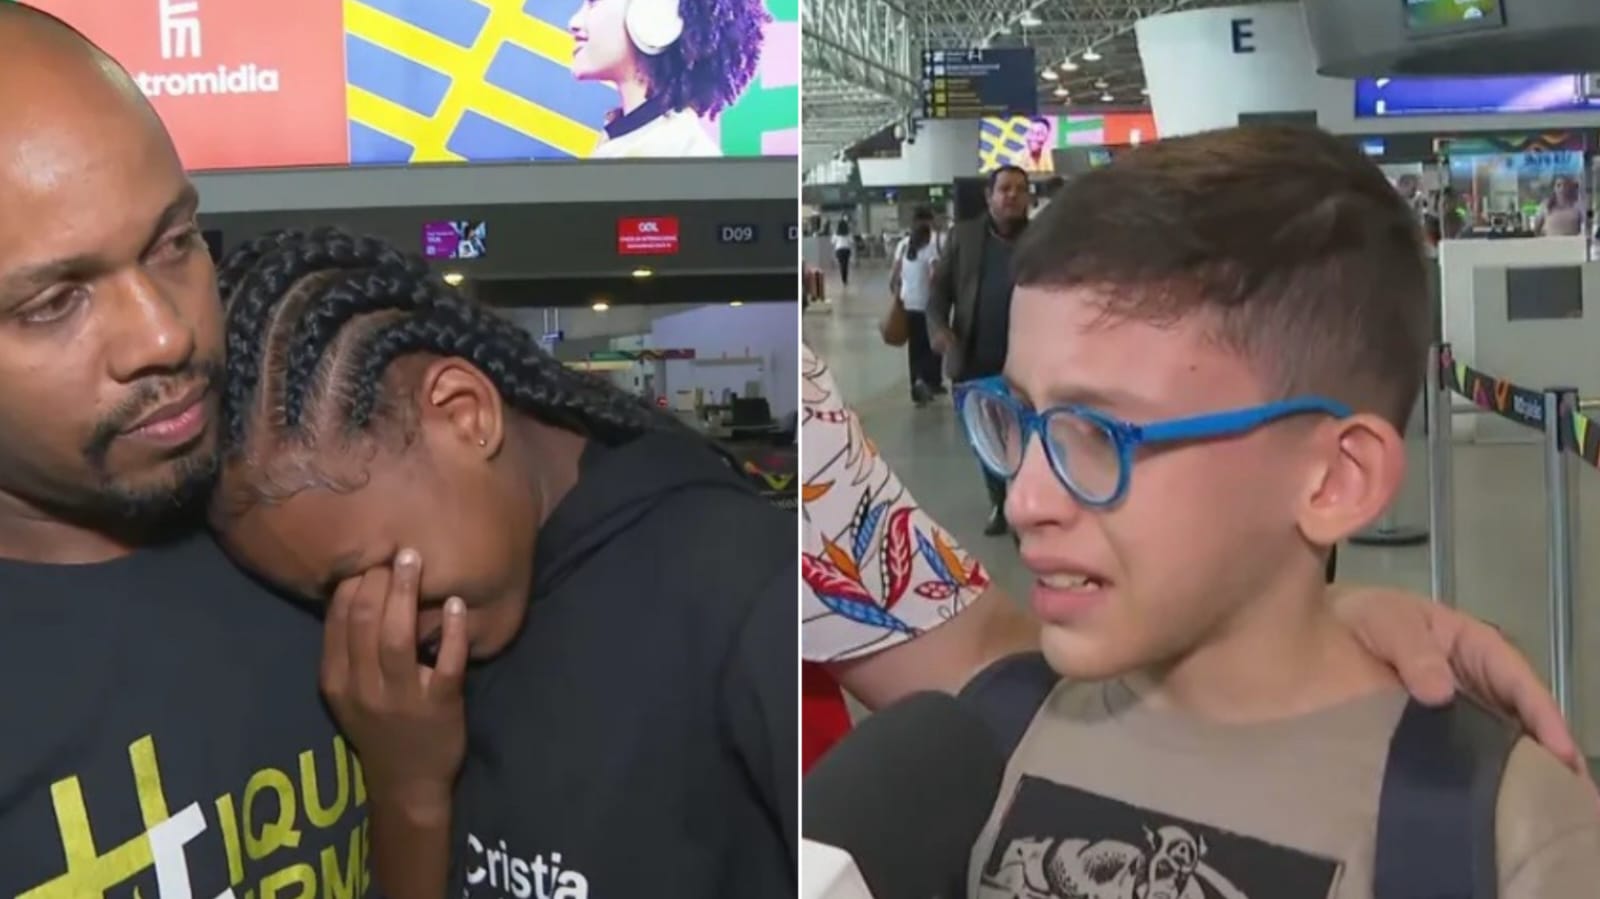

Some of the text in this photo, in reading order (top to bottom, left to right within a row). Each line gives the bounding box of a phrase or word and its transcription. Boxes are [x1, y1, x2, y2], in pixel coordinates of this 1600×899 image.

[1230, 18, 1256, 54] E
[134, 63, 279, 97] tromidia
[722, 226, 753, 241] D09
